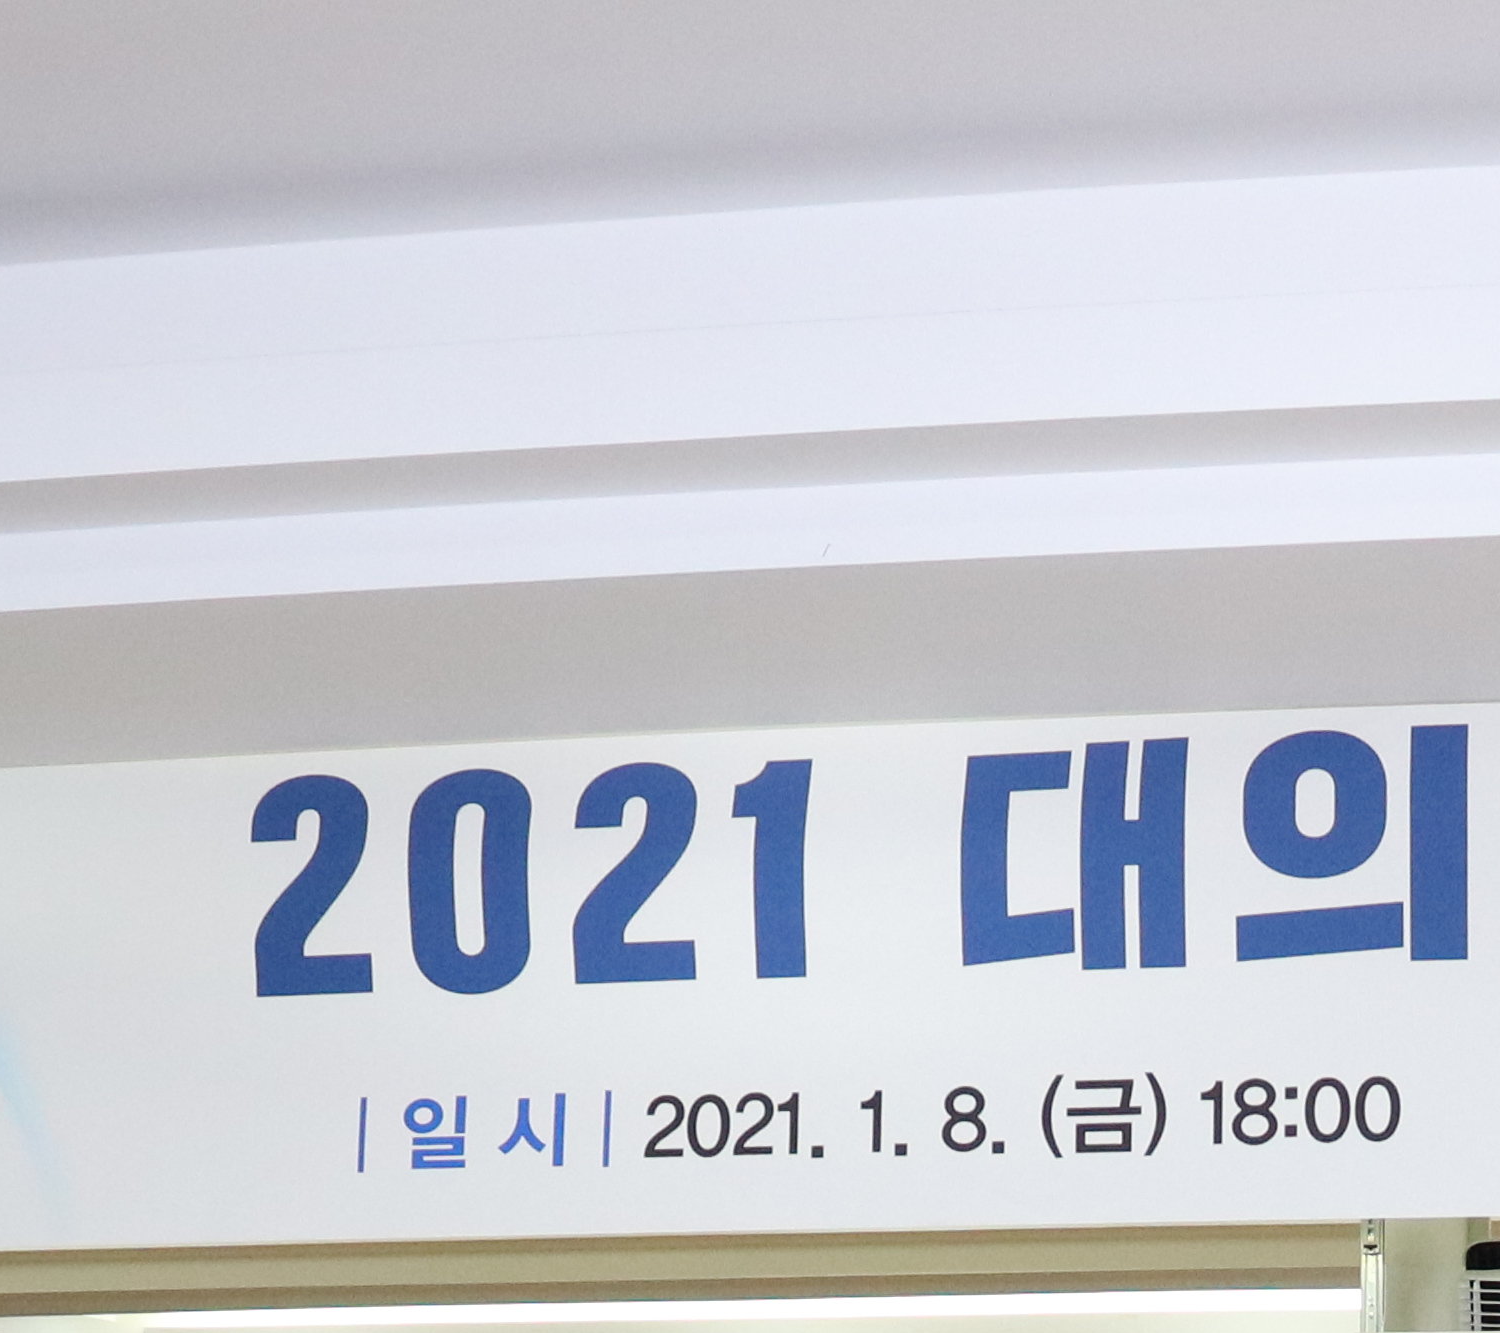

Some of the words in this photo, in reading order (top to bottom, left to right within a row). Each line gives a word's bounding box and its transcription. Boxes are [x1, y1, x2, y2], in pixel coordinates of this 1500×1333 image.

[251, 759, 812, 997] 2021
[645, 1093, 823, 1158] 2021.
[861, 1091, 907, 1156] 1.
[942, 1086, 1004, 1154] 8.
[1042, 1073, 1166, 1158] (금)
[1201, 1077, 1400, 1145] 18:00
